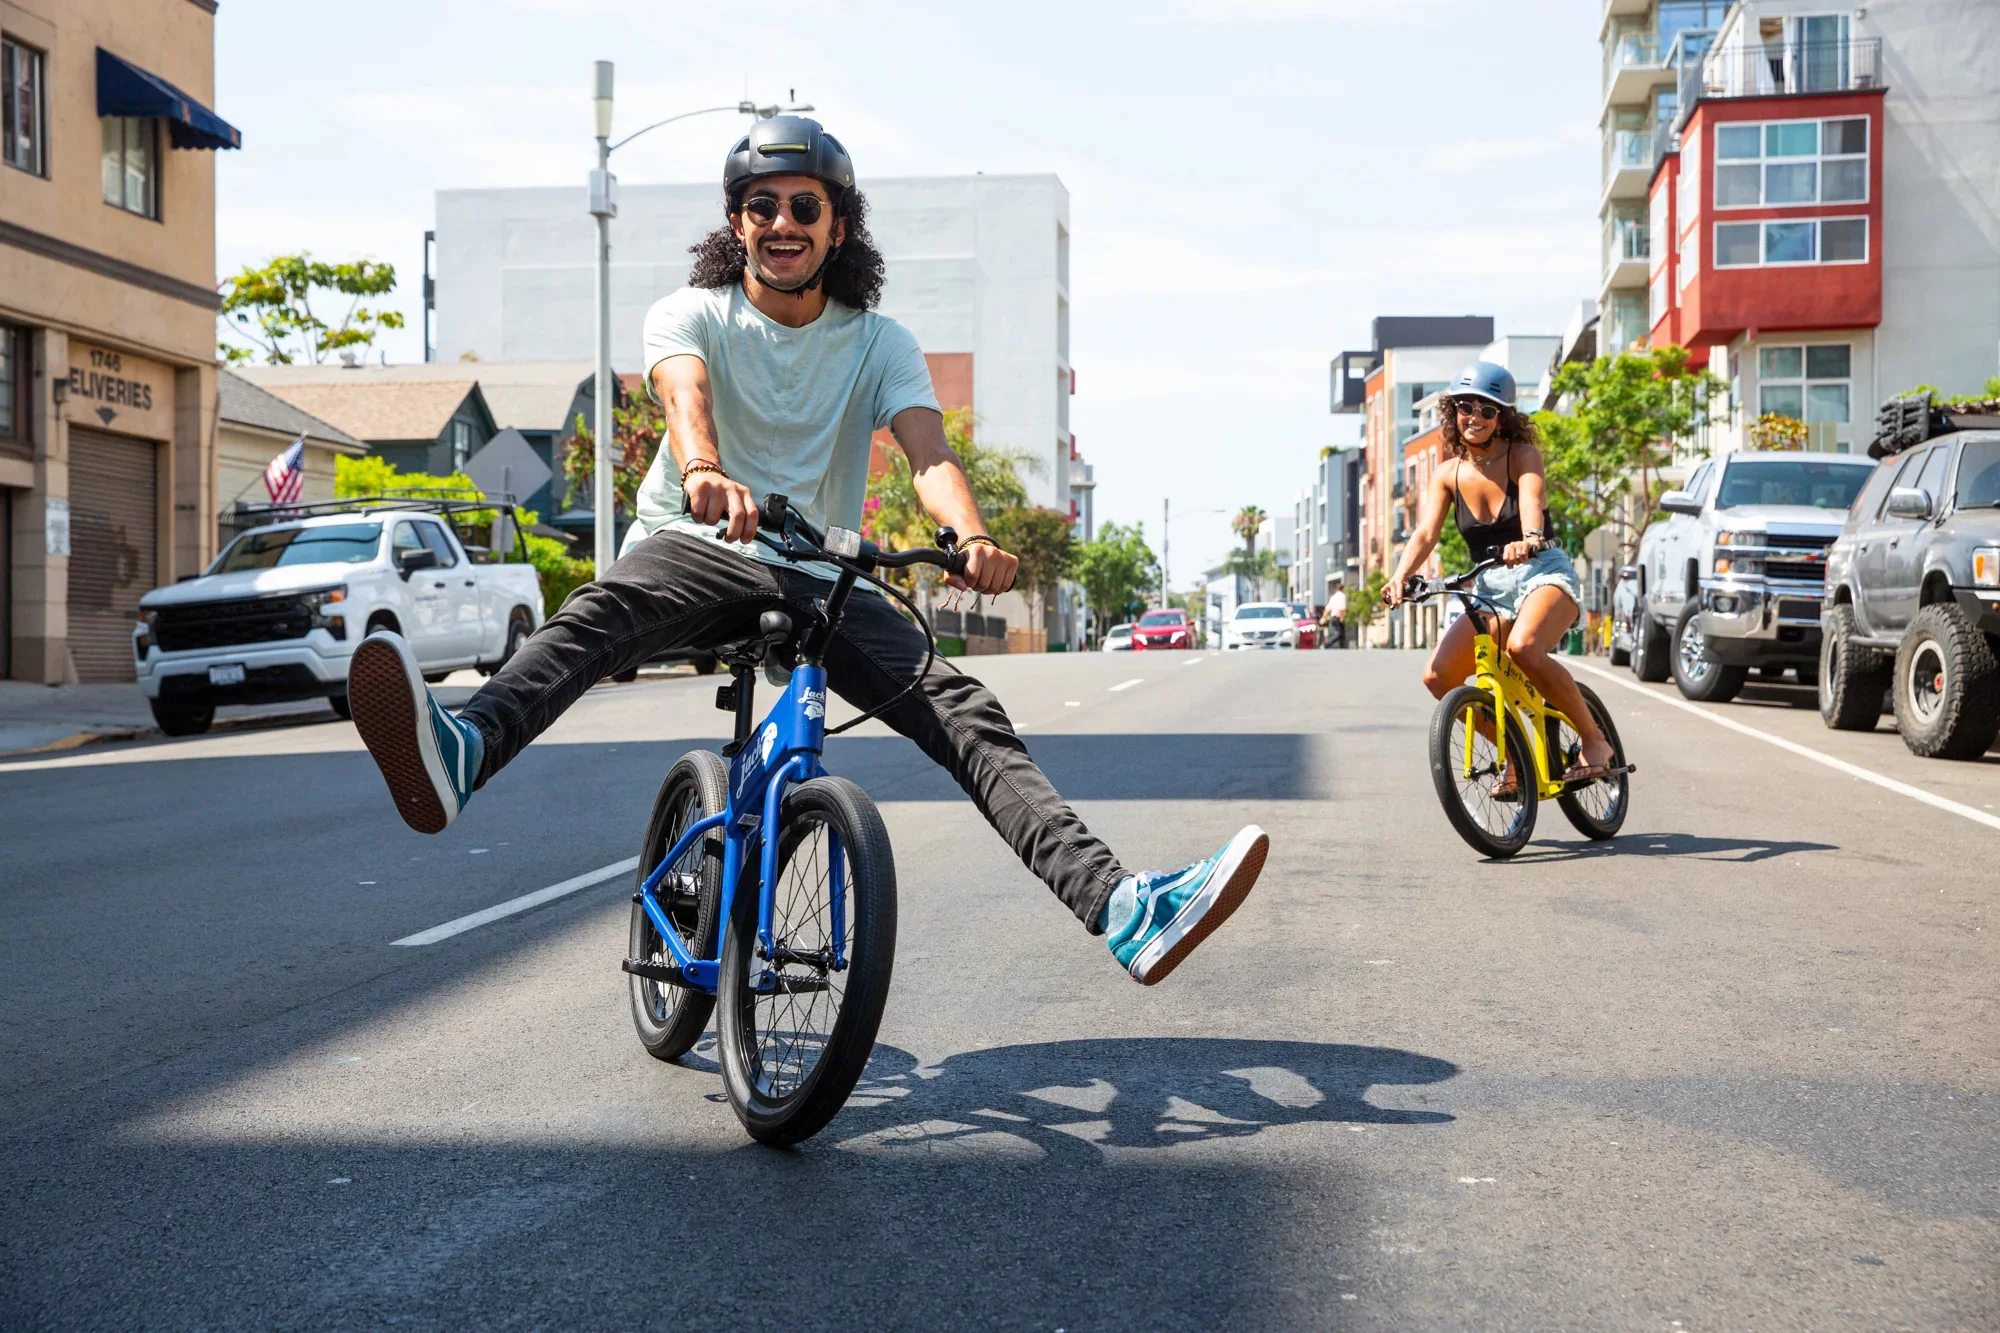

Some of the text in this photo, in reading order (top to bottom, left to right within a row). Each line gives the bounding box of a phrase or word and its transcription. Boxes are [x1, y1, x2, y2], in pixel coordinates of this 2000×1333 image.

[70, 366, 152, 411] ELIVERIES
[798, 687, 826, 704] jack
[736, 736, 762, 799] jack
